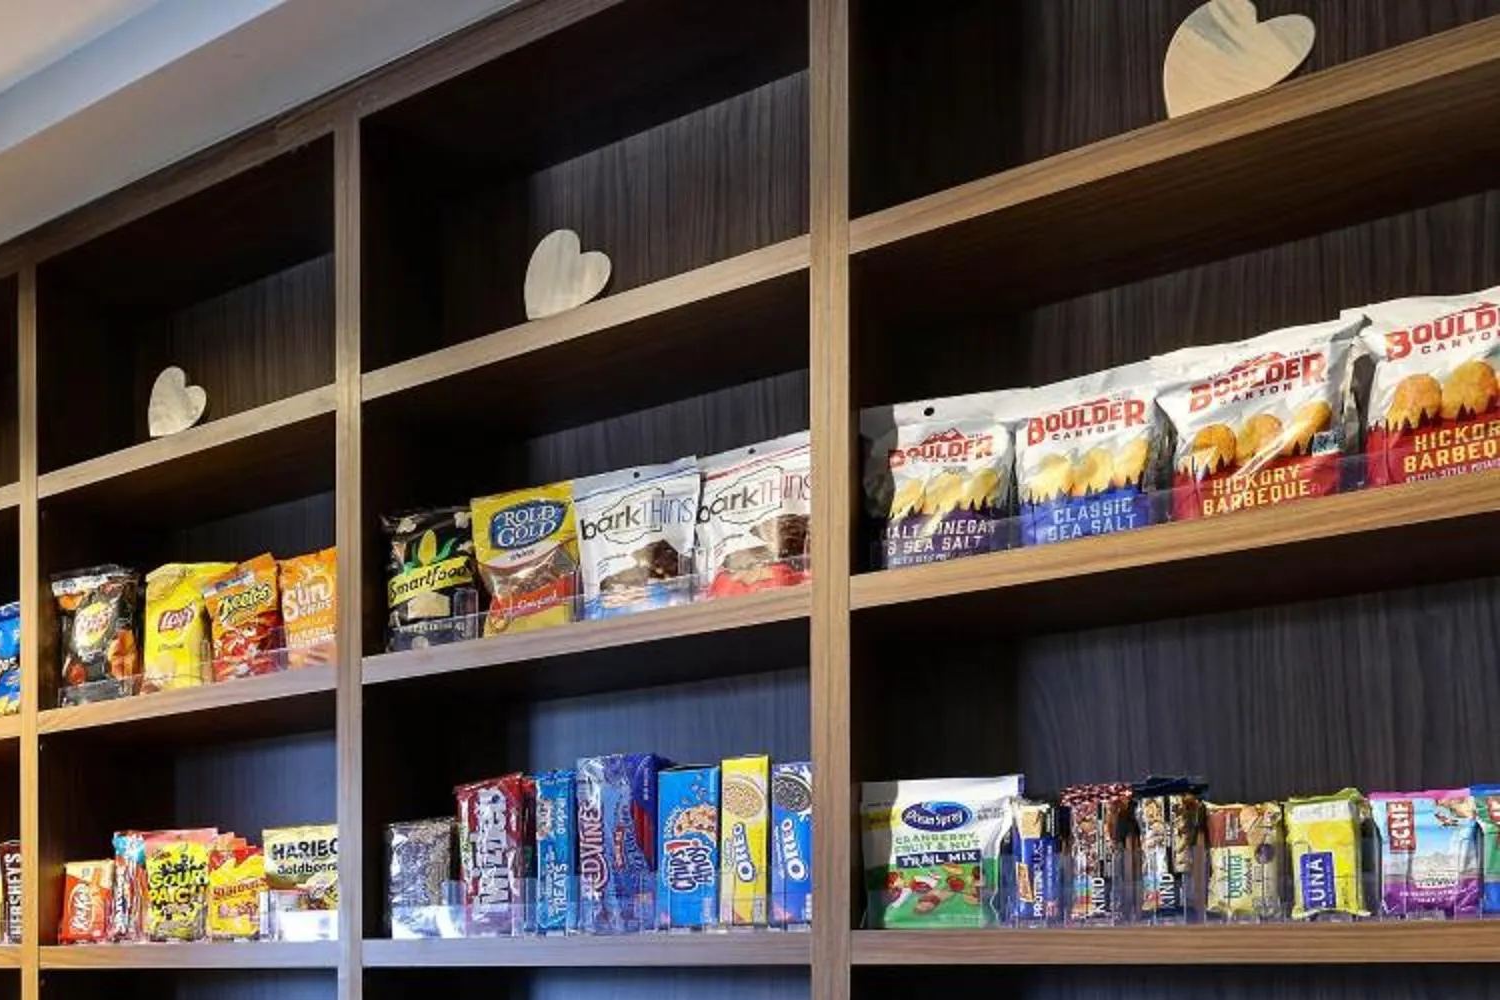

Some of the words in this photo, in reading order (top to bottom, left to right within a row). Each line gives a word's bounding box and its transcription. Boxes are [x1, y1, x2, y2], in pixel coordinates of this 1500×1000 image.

[1385, 306, 1500, 361] BOULD
[1188, 352, 1328, 413] BOULDER
[1027, 399, 1146, 447] BOULDER
[1213, 464, 1301, 496] HICKORY
[1053, 497, 1133, 524] CLASSIC
[1203, 479, 1312, 516] BARBEQUE
[504, 505, 557, 526] ROLD
[936, 519, 996, 537] INEGAR
[1048, 523, 1084, 543] SEA
[1090, 513, 1138, 535] SALT
[497, 519, 558, 548] GOLD
[903, 540, 935, 554] SEA
[942, 537, 984, 552] SALT
[732, 823, 758, 882] OREO
[781, 818, 809, 882] OREO
[948, 850, 978, 865] MIX
[1092, 876, 1106, 913] KIND
[1158, 872, 1175, 909] KIND
